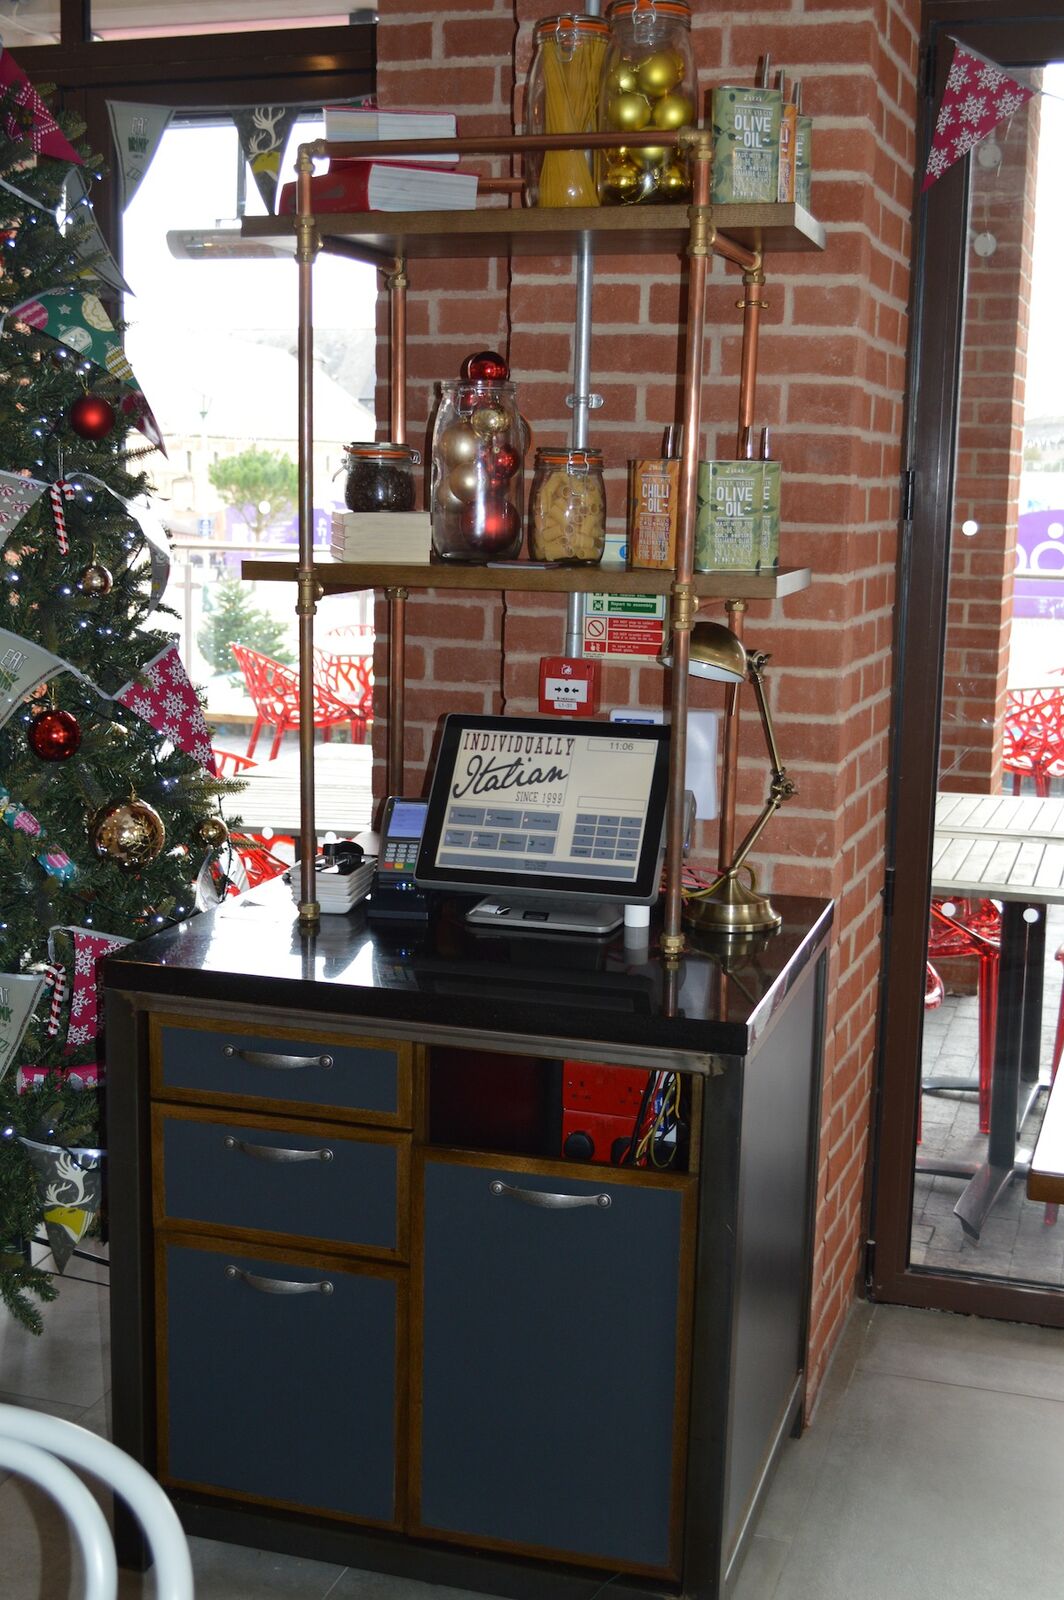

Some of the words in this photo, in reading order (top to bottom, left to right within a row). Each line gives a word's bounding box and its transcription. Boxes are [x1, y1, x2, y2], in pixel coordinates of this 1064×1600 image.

[734, 114, 772, 132] OLIVE
[743, 131, 763, 148] OIL
[641, 482, 669, 499] CHILLI
[716, 486, 753, 502] OLIVE
[647, 498, 662, 512] OIL
[725, 501, 745, 516] OIL
[0, 648, 28, 671] EAT
[463, 732, 575, 756] INDIVIDUALLY
[609, 742, 634, 751] 11:06
[452, 754, 568, 799] Italian
[515, 791, 539, 803] SINCE
[541, 792, 562, 804] 1999
